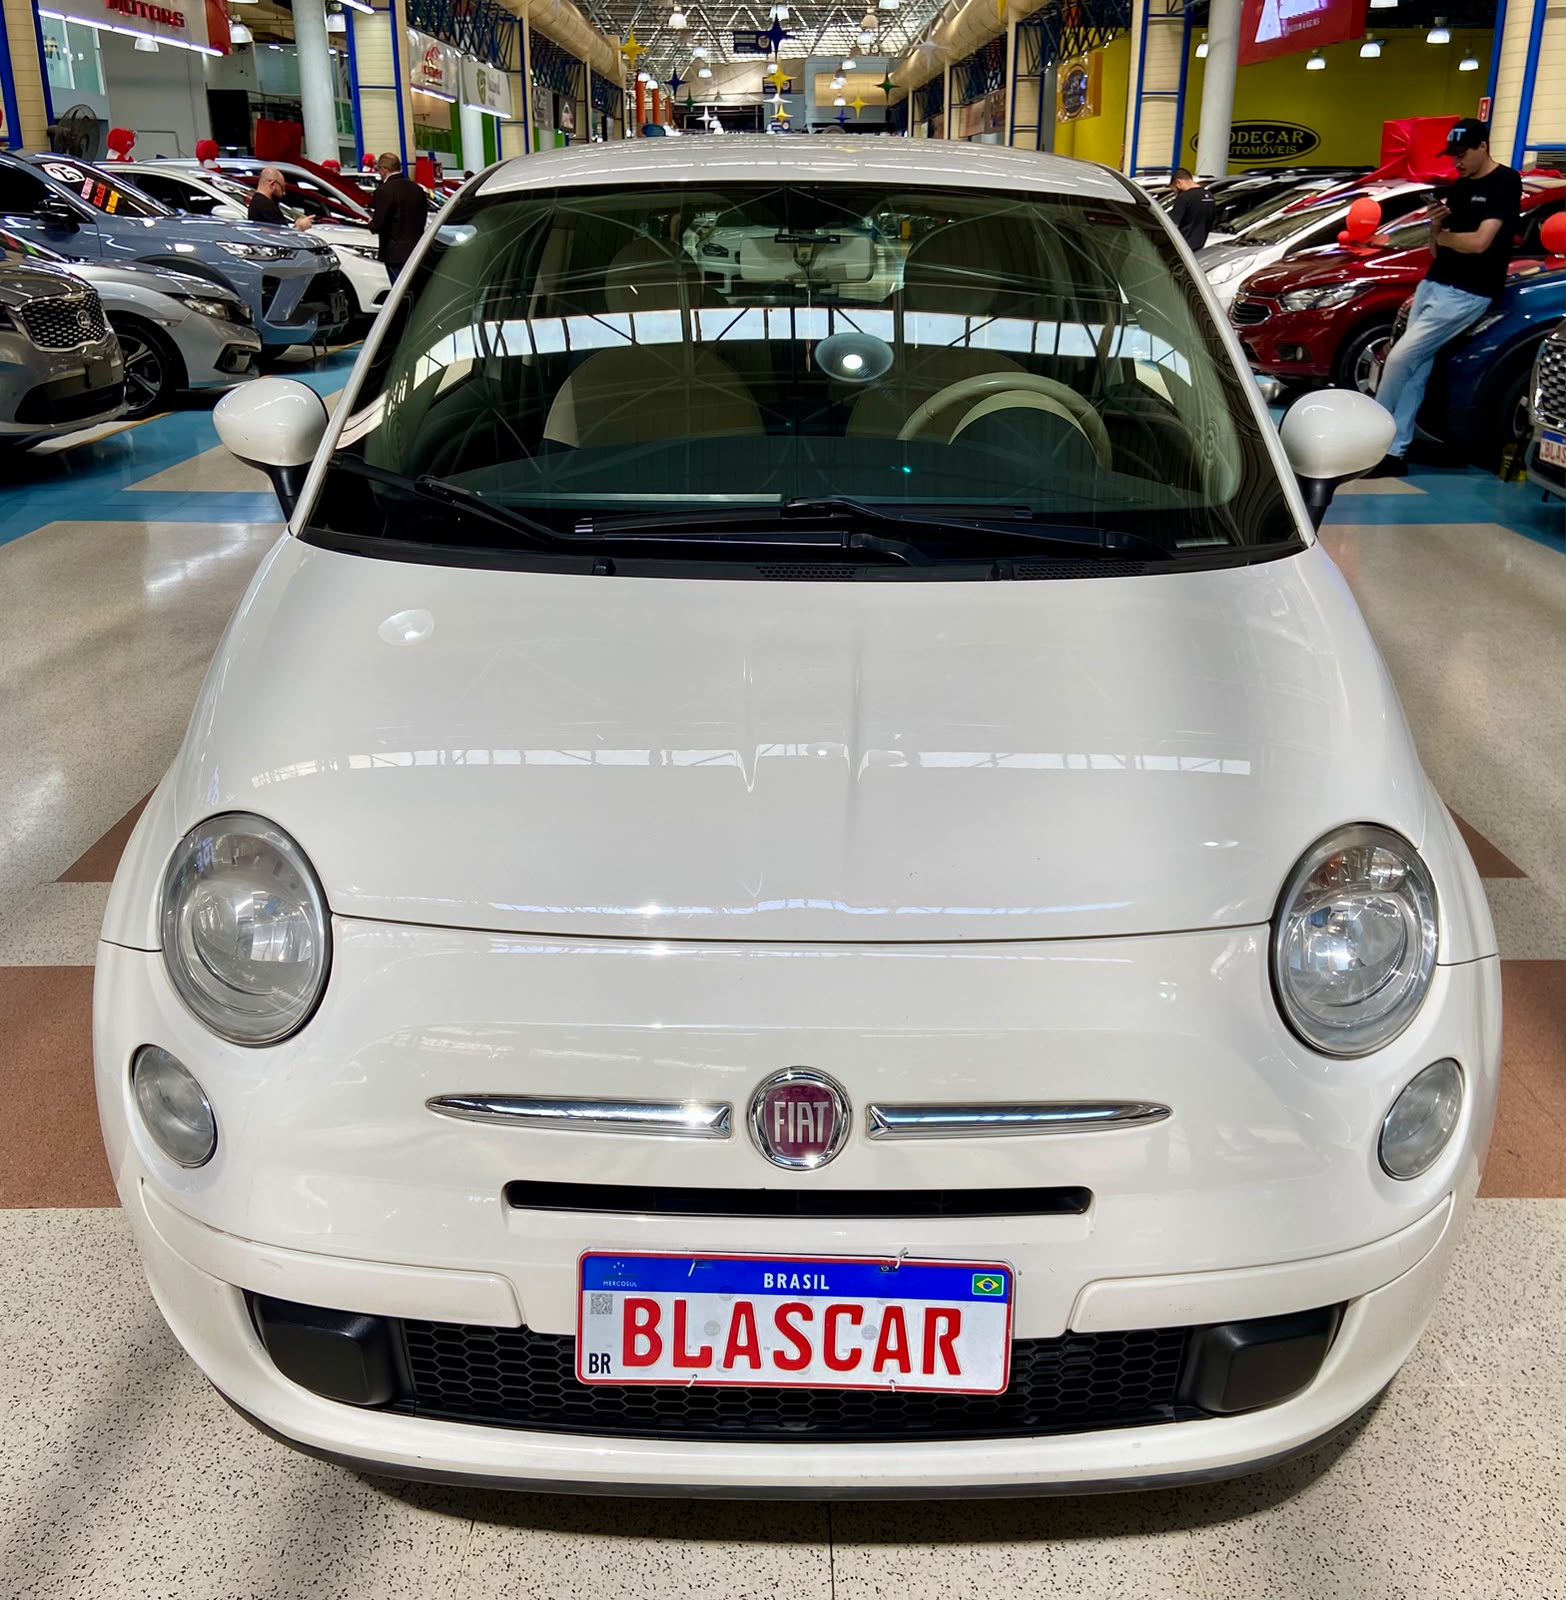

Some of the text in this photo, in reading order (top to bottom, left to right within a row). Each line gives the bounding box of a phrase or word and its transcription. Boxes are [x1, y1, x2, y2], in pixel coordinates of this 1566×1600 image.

[1229, 144, 1297, 155] TOMÓVEIS
[774, 1101, 829, 1143] FIAT
[602, 1280, 638, 1288] MERCOSUL
[763, 1273, 830, 1290] BRASIL
[622, 1297, 962, 1376] BLASCAR
[588, 1352, 612, 1375] BR
